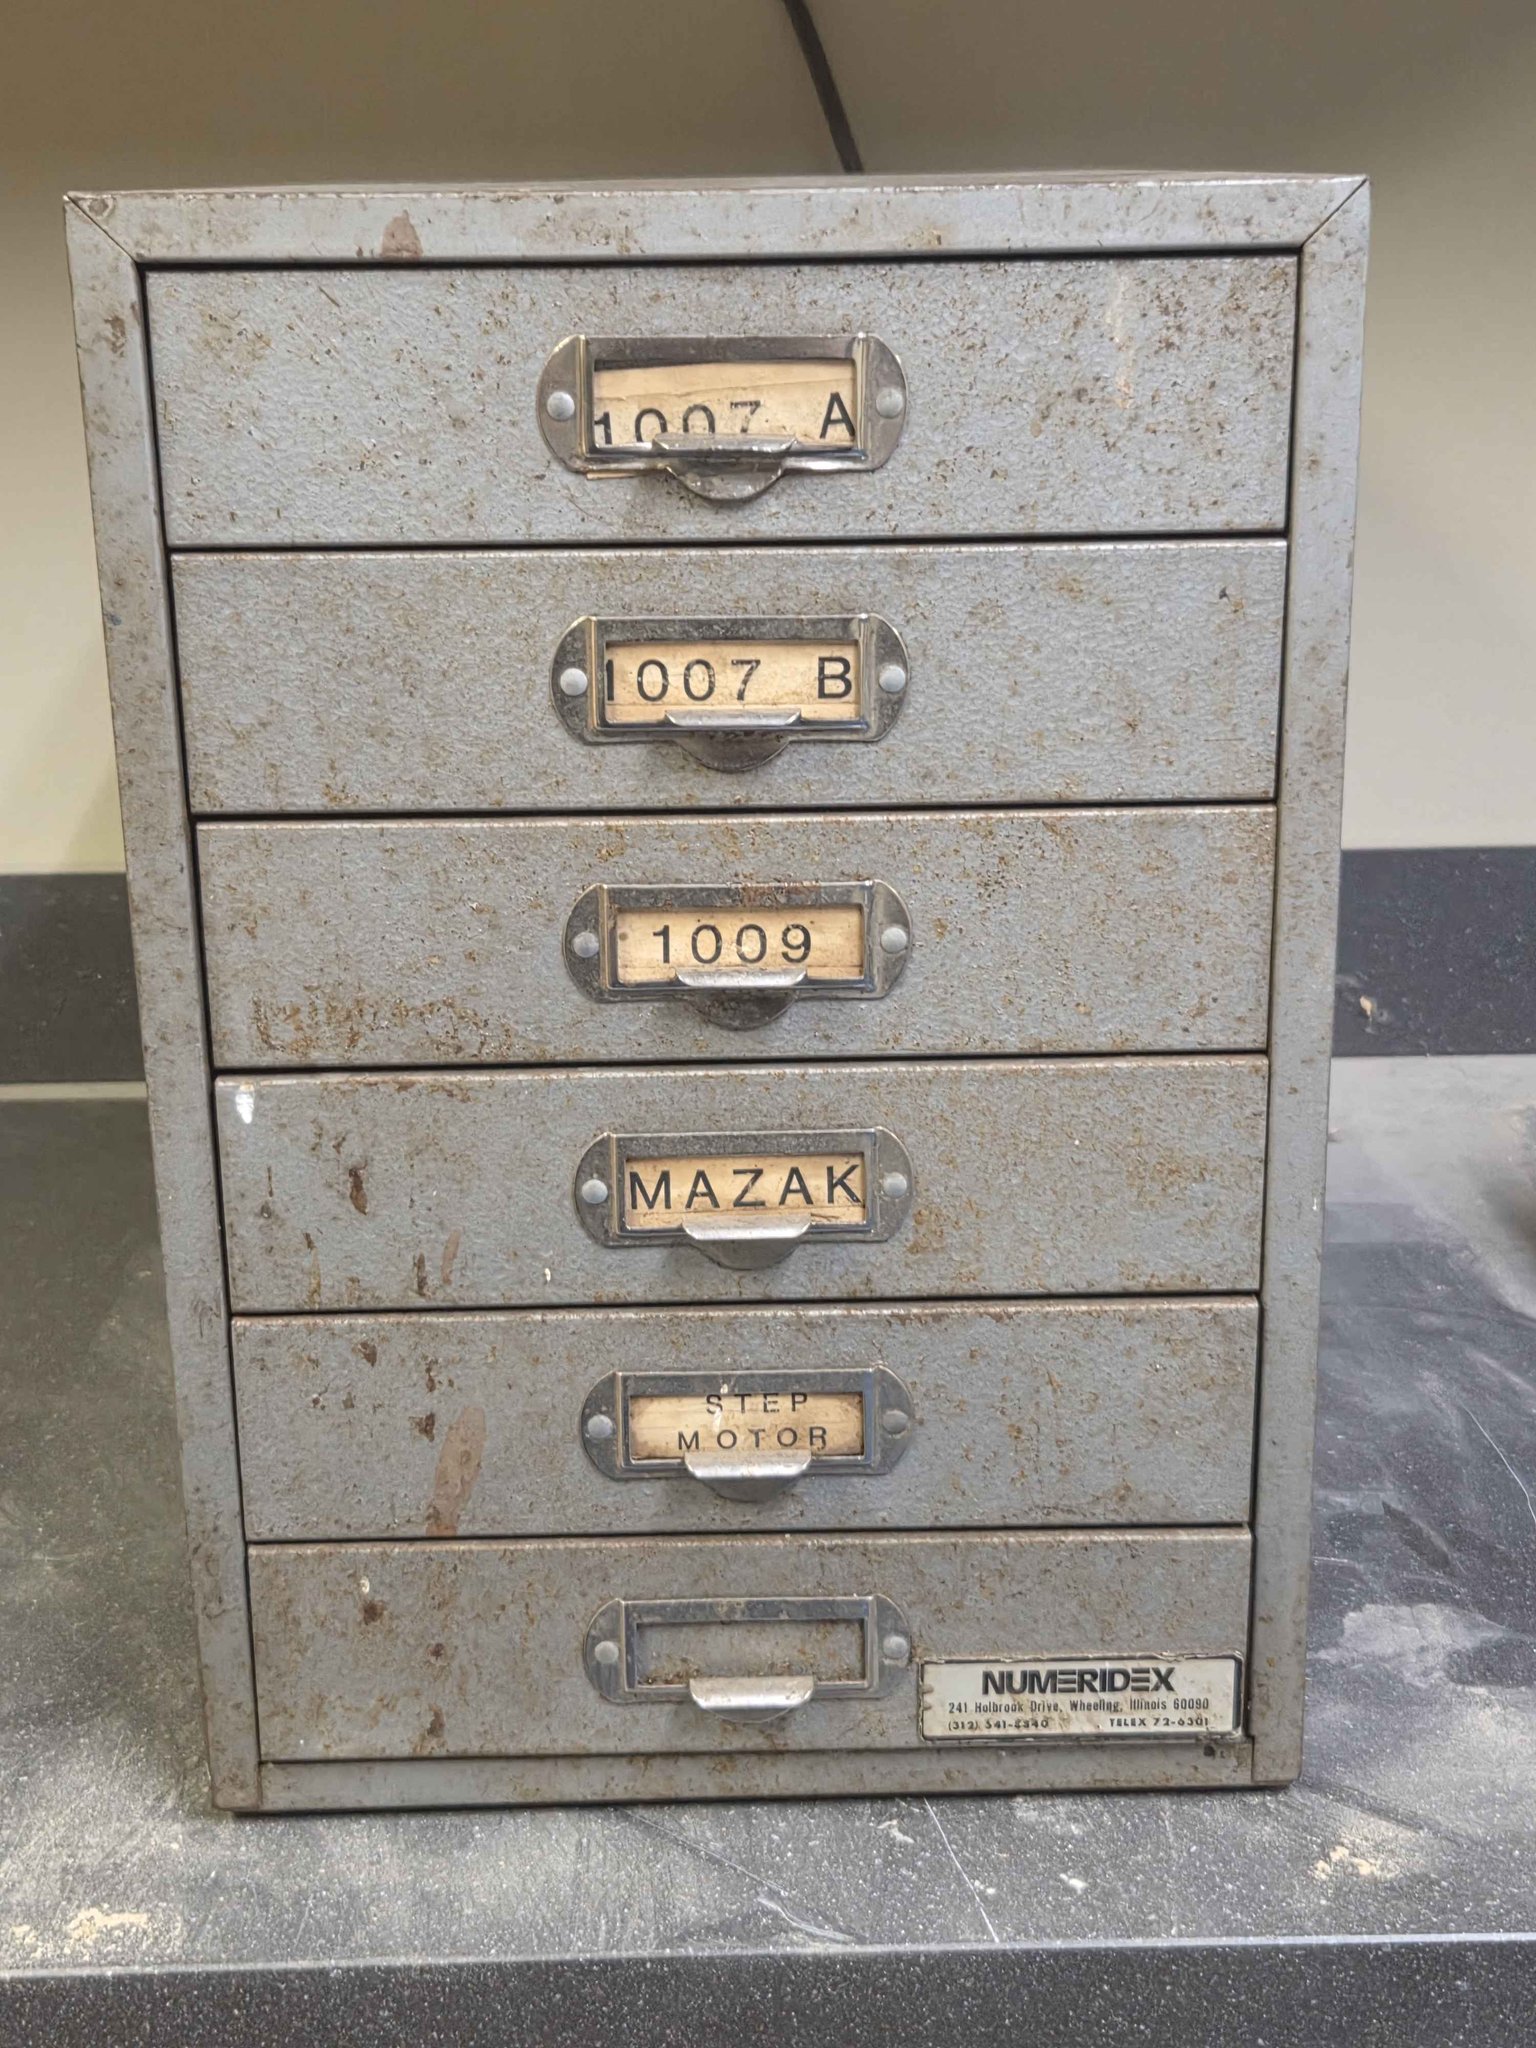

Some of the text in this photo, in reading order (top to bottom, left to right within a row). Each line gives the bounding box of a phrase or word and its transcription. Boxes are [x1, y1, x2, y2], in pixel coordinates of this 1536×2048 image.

[819, 391, 855, 440] A
[605, 655, 853, 701] 1007 B
[652, 923, 812, 964] 1009
[629, 1163, 863, 1210] MAZAK
[705, 1392, 809, 1415] STEP
[677, 1425, 828, 1451] MOTOR
[981, 1666, 1176, 1696] NUMERIDEX
[948, 1697, 1210, 1714] 241 Holbrook Drive, Wheeling, Illinois 60090
[948, 1720, 979, 1731] (312)
[1109, 1717, 1147, 1727] TELEX
